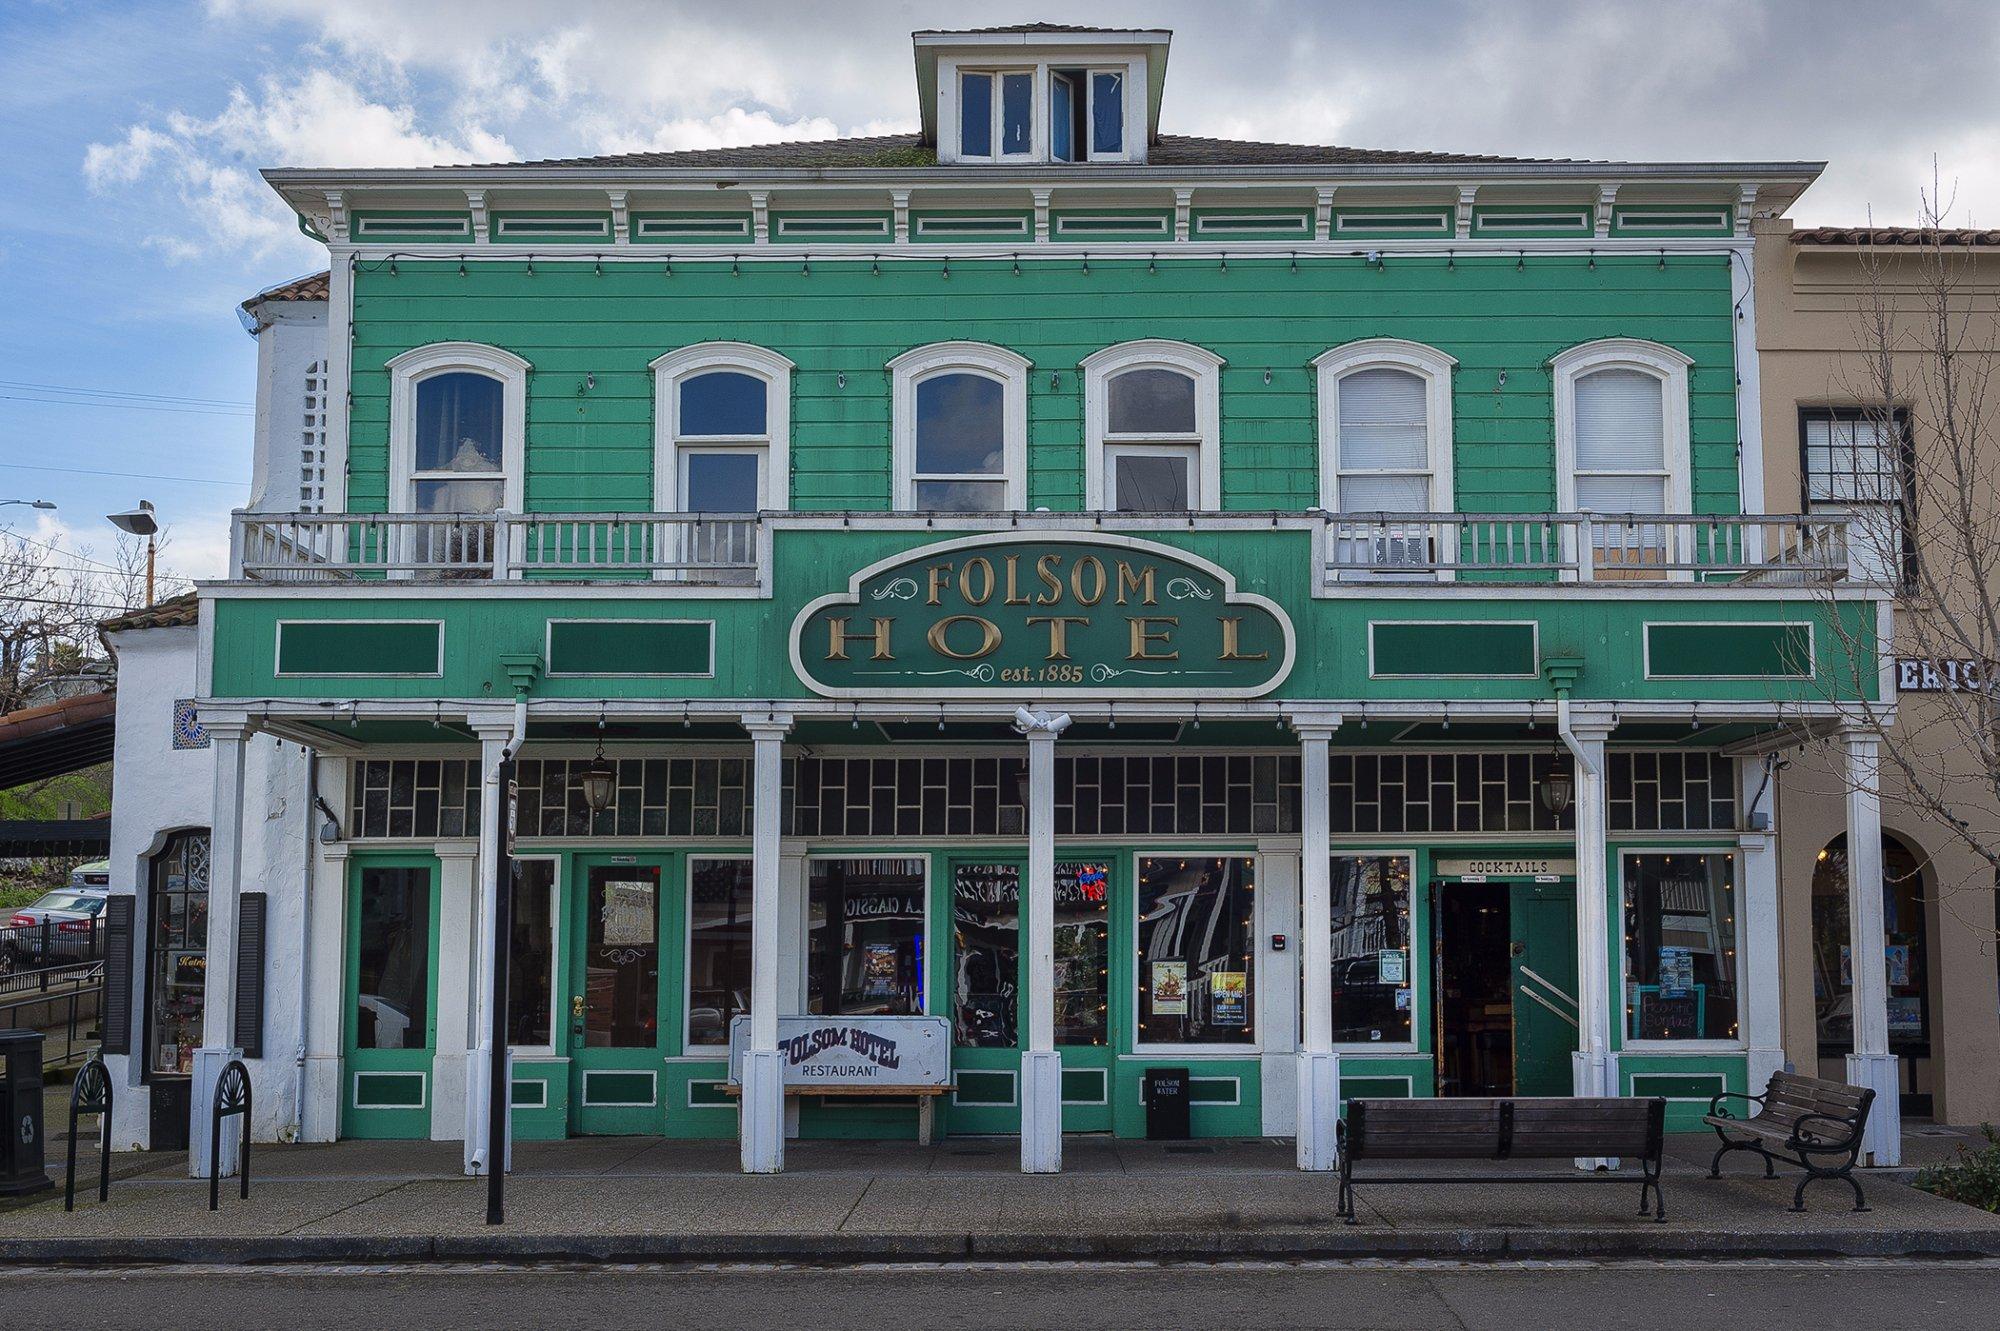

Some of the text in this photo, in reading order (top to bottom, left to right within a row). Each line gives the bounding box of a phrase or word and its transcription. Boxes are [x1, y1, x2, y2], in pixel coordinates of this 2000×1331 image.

[925, 554, 1159, 606] FOLSOM
[824, 613, 1269, 660] HOTEL
[1469, 861, 1547, 873] COCKTAILS
[778, 1027, 900, 1070] FOLSOM HOTEL
[802, 1065, 879, 1077] RESTAURANT
[1156, 1087, 1178, 1095] WATER
